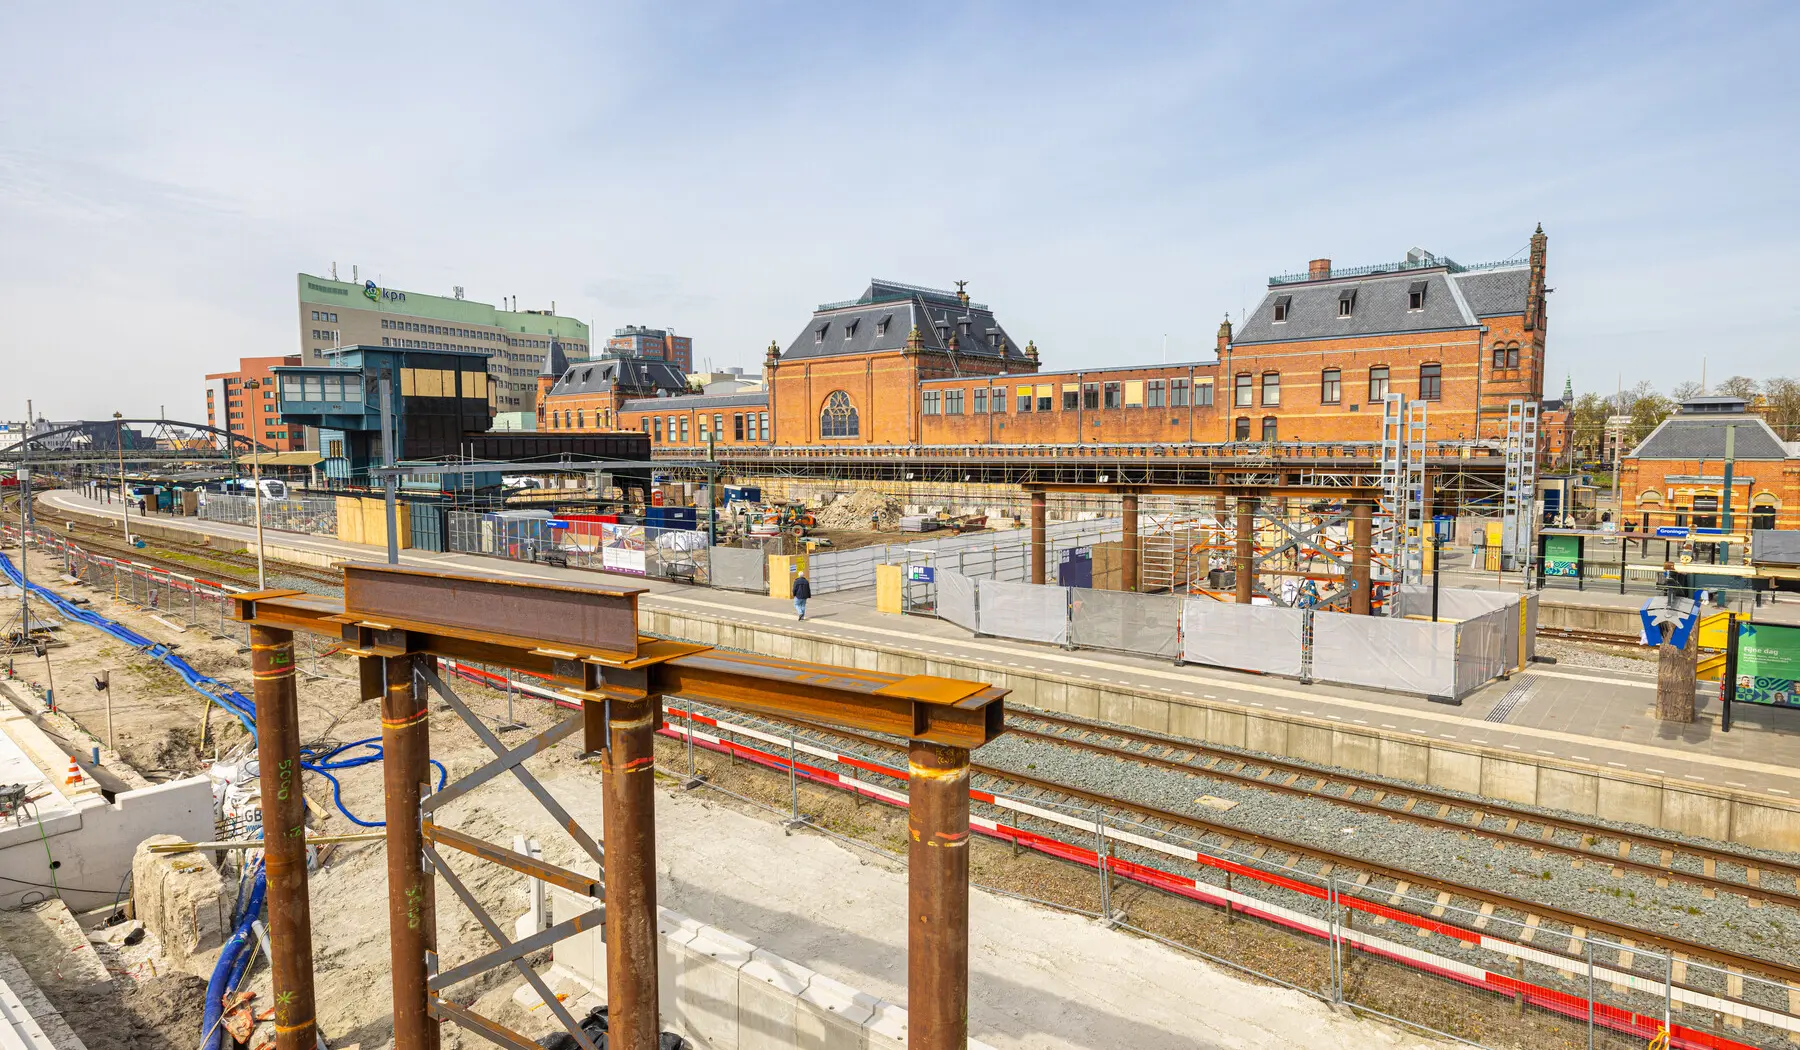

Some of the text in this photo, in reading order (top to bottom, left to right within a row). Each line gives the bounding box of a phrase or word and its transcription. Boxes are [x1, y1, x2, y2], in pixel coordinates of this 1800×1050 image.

[382, 287, 405, 302] kpn
[1743, 646, 1779, 656] Fijne dag
[277, 759, 292, 801] 5000
